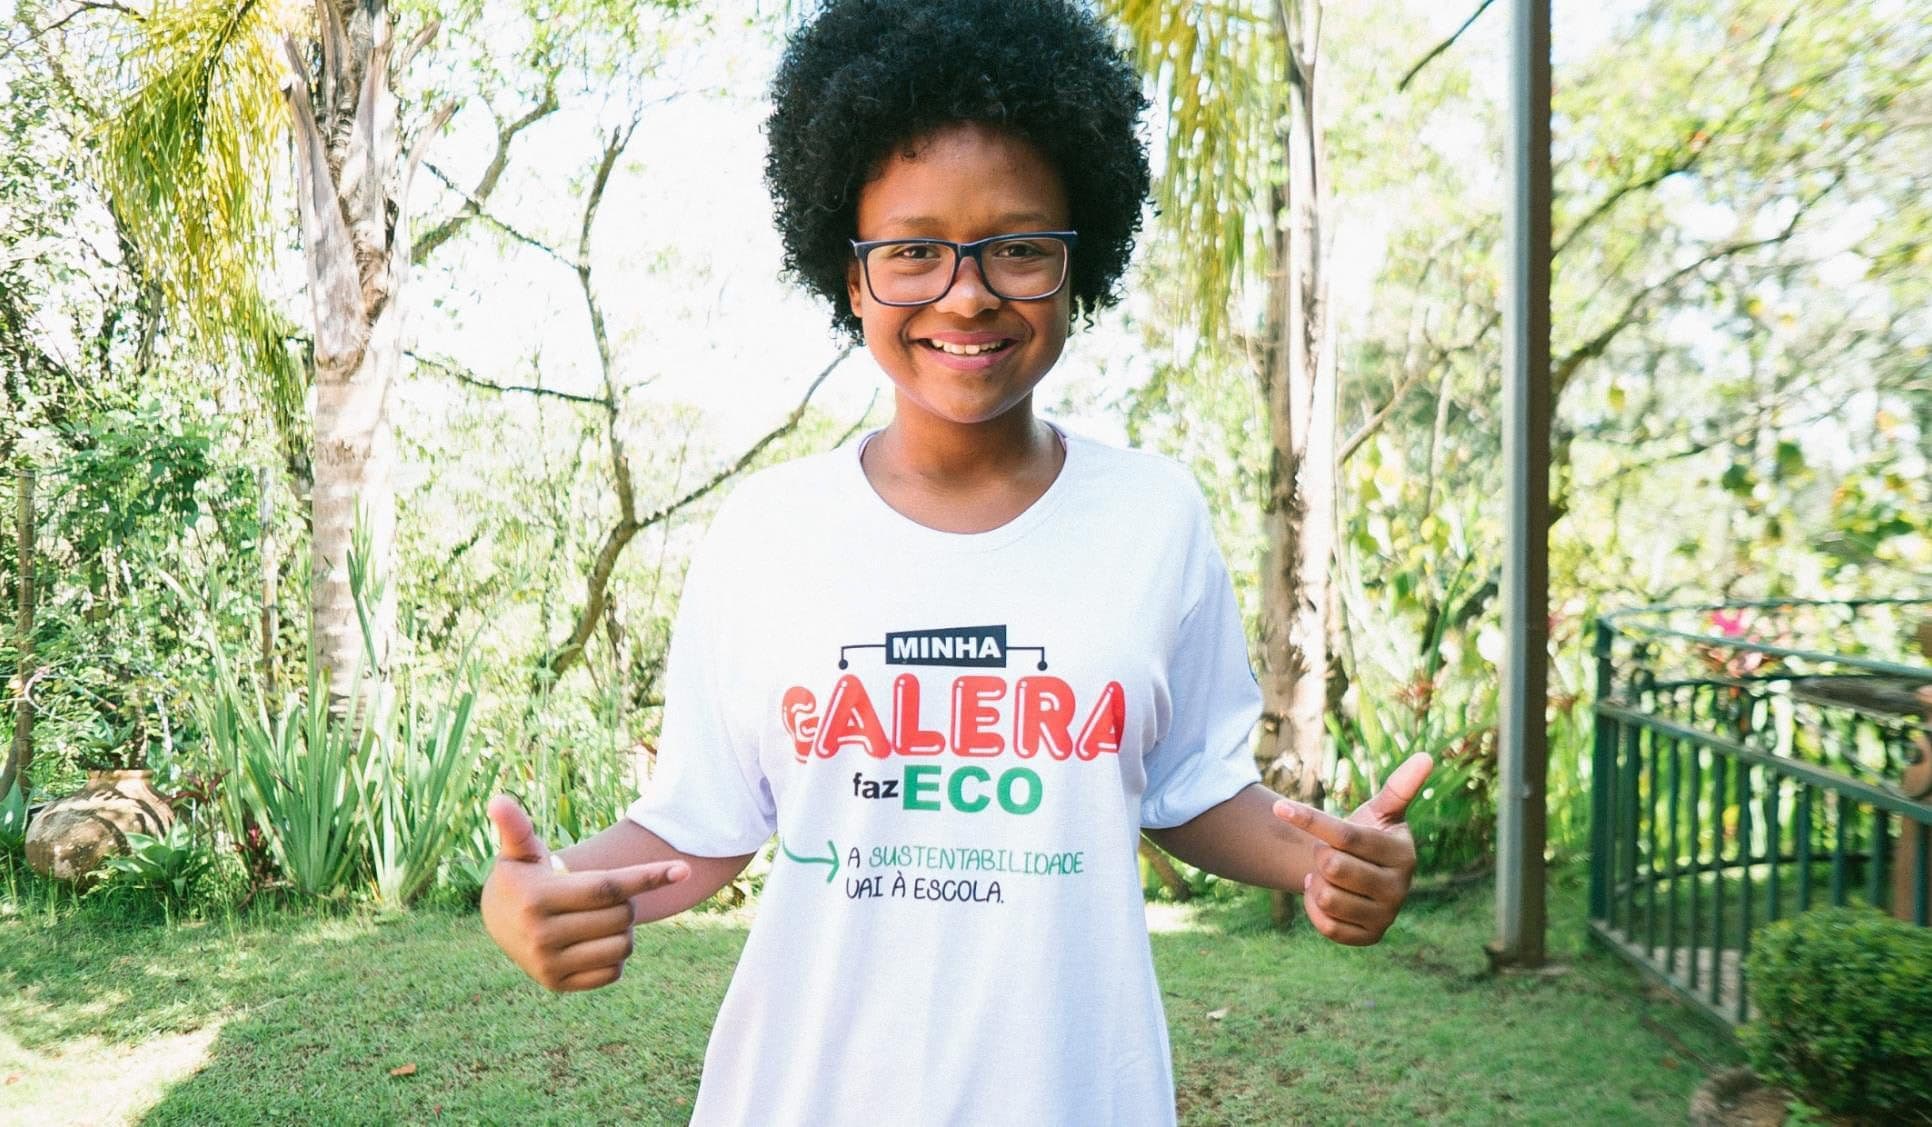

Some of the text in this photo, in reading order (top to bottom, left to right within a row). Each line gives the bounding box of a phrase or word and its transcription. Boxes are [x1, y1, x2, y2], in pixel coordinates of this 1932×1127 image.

[892, 637, 1002, 659] MINHA
[853, 765, 1043, 815] faz ECO
[847, 846, 1084, 875] A SUSTENTABILIDADE
[891, 870, 906, 898] À
[914, 878, 1004, 904] ESCOLA.
